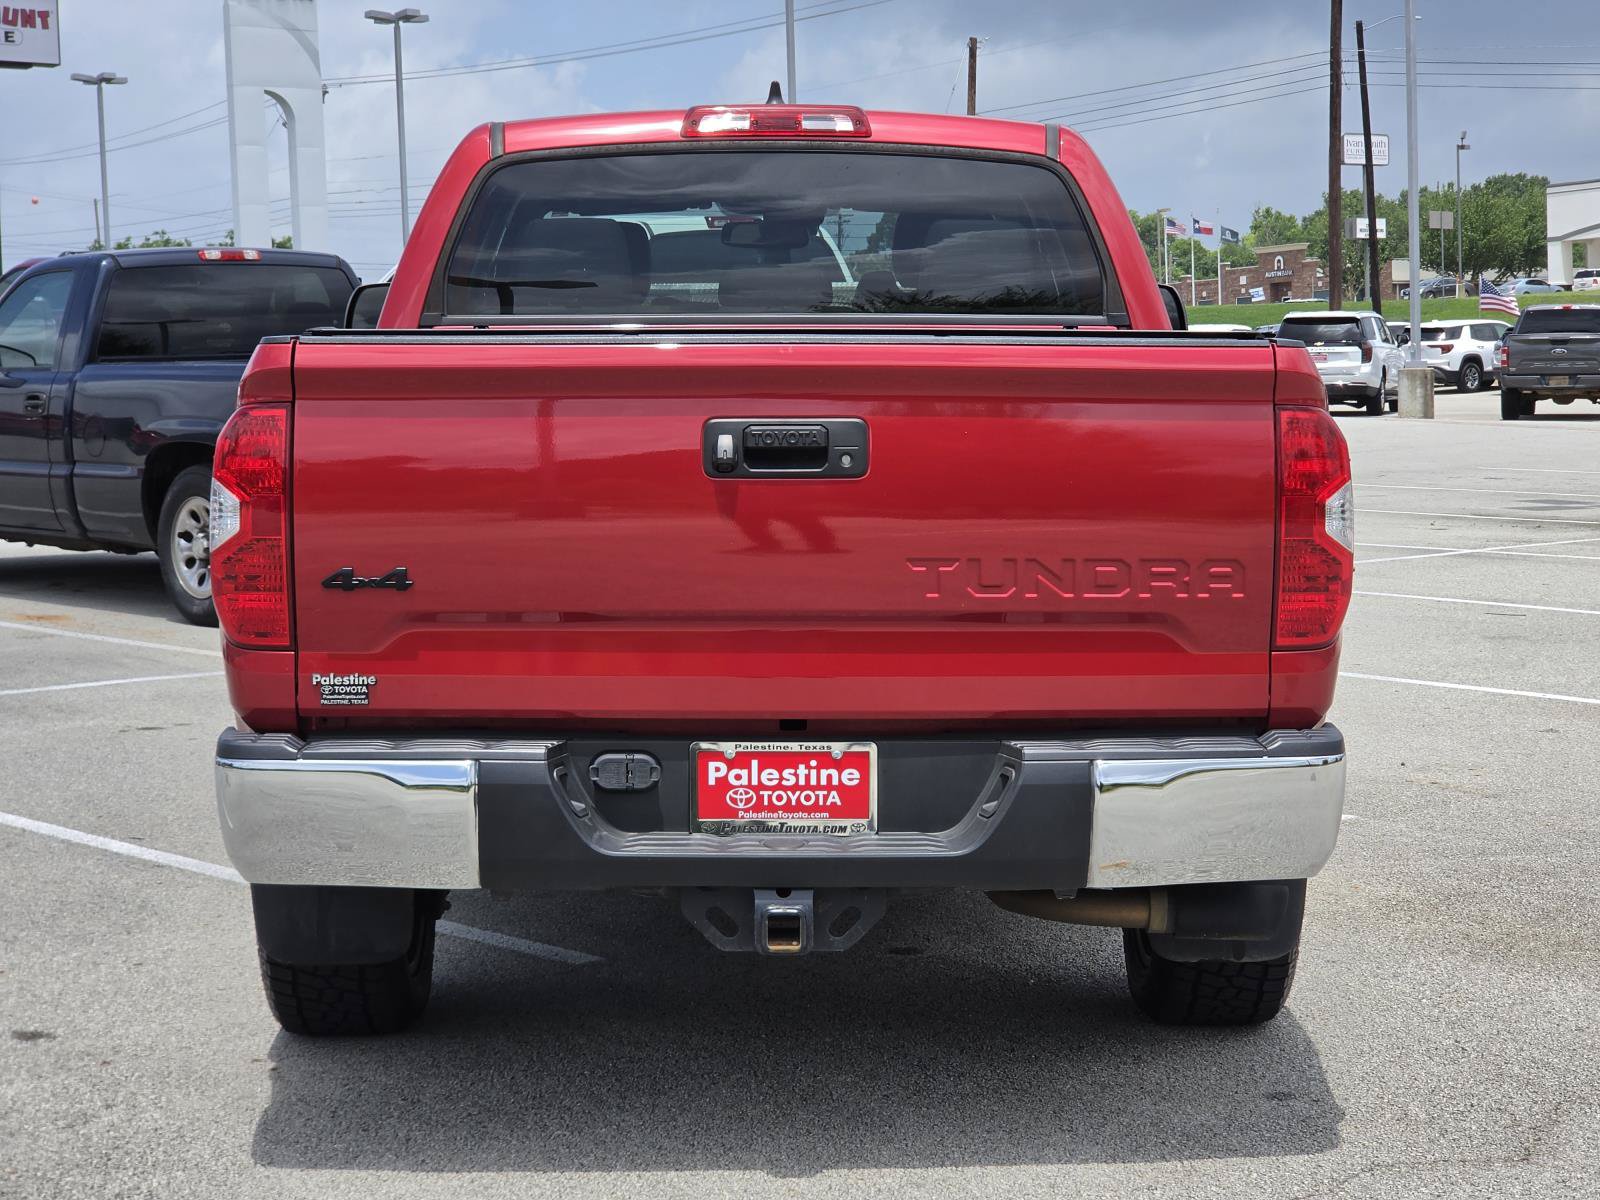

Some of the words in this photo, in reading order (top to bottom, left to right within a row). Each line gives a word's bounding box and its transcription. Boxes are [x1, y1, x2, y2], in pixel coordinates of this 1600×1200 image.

[0, 6, 50, 30] UNT
[4, 31, 16, 43] E
[1346, 139, 1363, 148] Ivan
[1370, 140, 1387, 149] mith
[751, 430, 821, 446] TOYOTA
[321, 567, 414, 591] 4x4
[906, 558, 1246, 598] TUNDRA
[312, 673, 377, 685] Palestine
[707, 759, 861, 786] Palestine
[760, 790, 842, 806] TOYOTA
[738, 811, 829, 819] PalestineToyota.com
